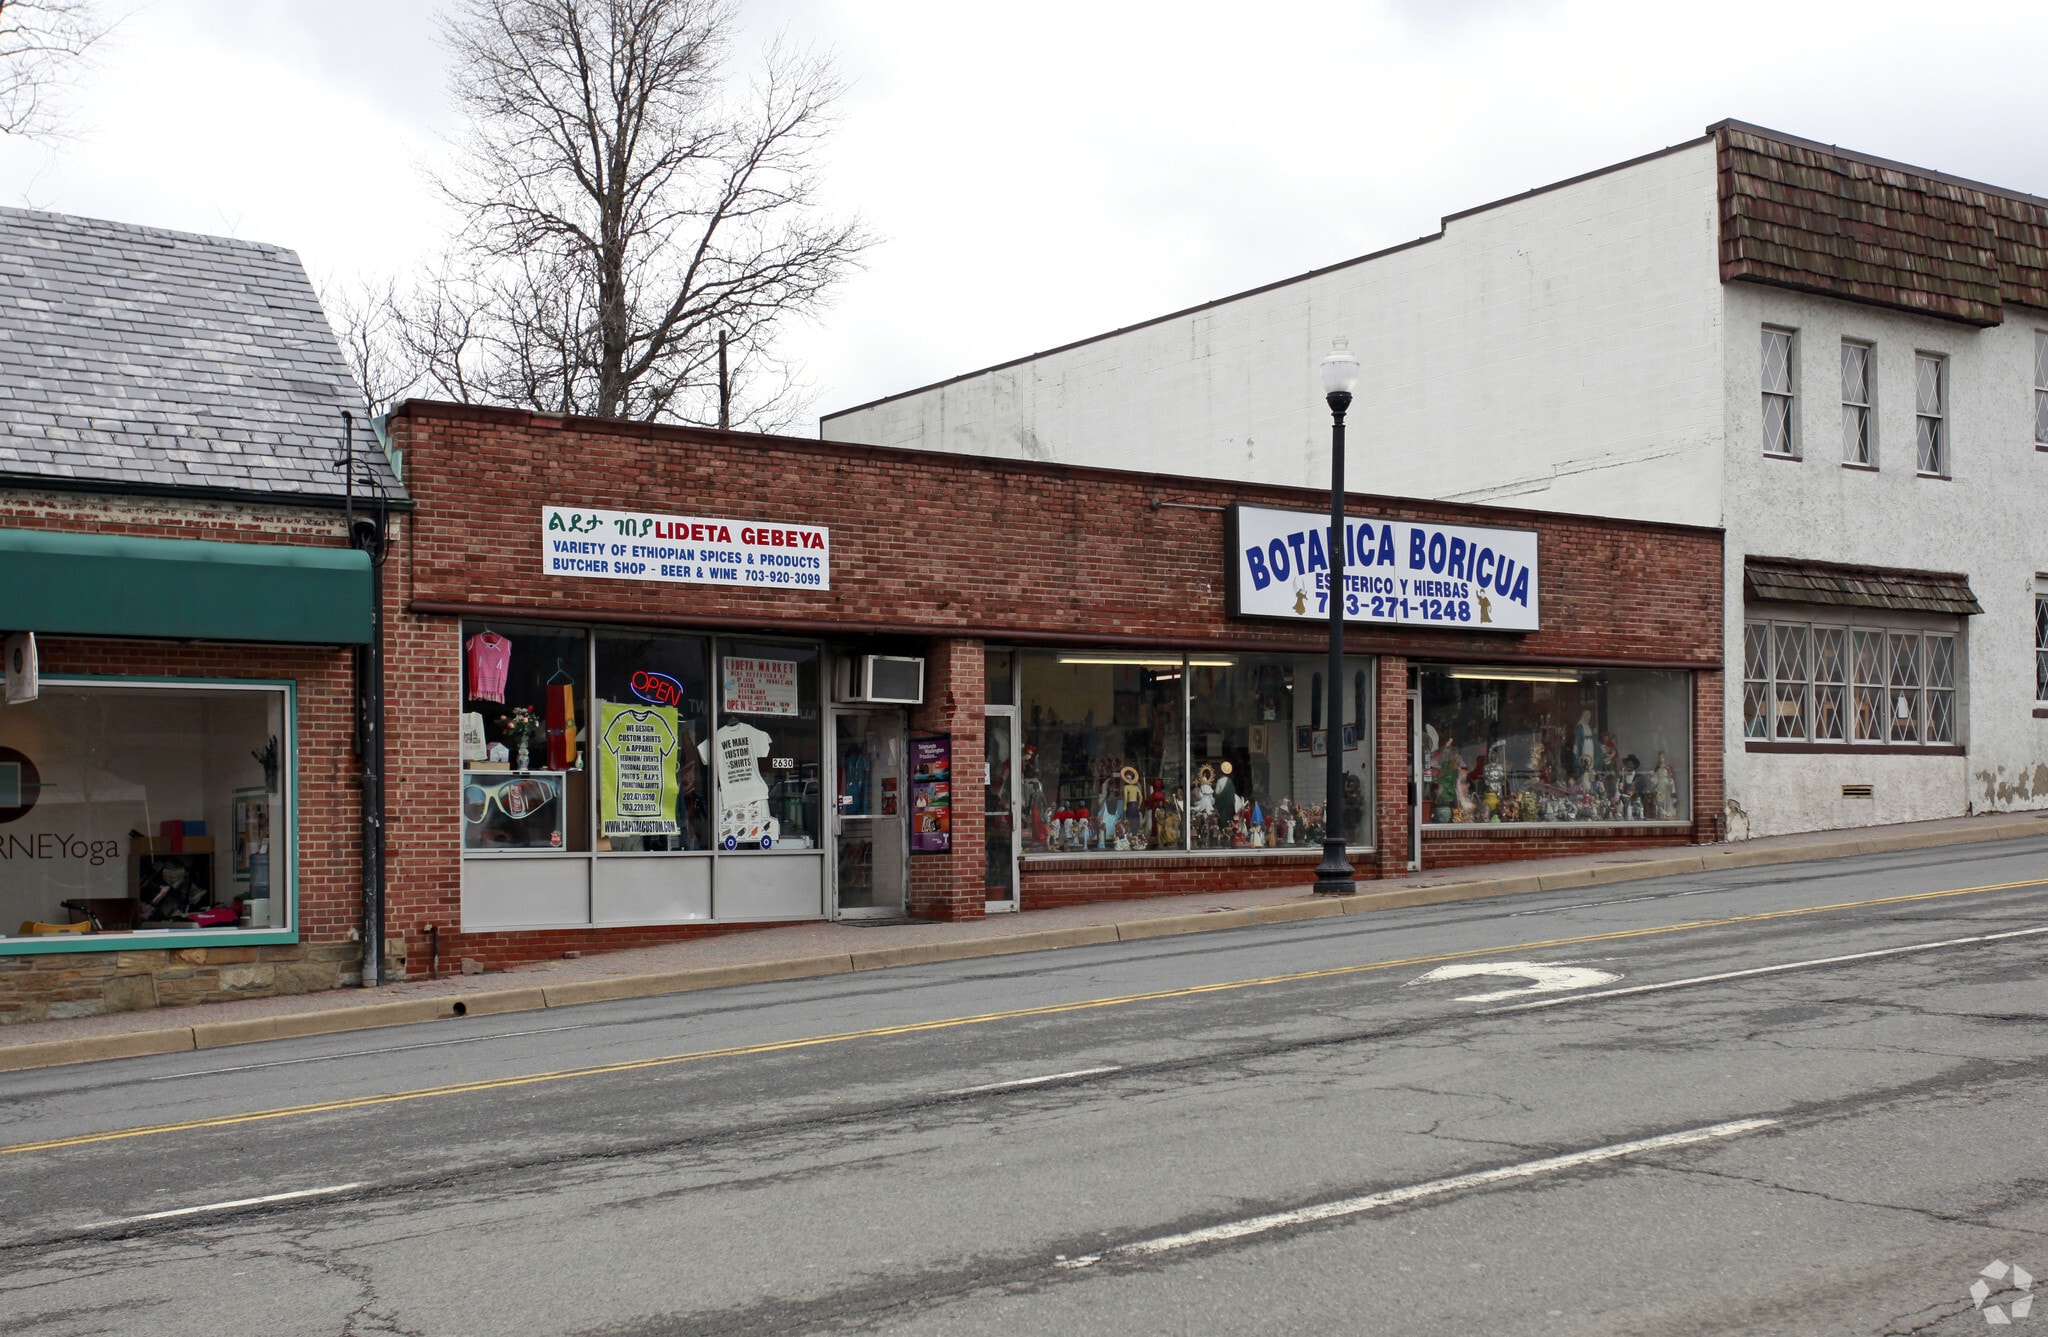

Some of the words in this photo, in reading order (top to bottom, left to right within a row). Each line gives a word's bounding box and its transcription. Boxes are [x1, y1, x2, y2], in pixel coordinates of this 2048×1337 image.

[549, 511, 603, 534] ልደታ
[655, 521, 732, 543] LIDETA
[741, 527, 825, 549] GEBEYA
[553, 540, 606, 556] VARIETY
[611, 543, 627, 557] OF
[632, 545, 695, 561] ETHIOPIAN
[700, 550, 742, 564] SPICES
[747, 553, 755, 564] &
[760, 554, 820, 569] PRODUCTS
[553, 557, 609, 573] BUTCHER
[614, 561, 646, 575] SHOP
[661, 564, 691, 578] BEER
[696, 566, 704, 578] &
[709, 567, 738, 580] WINE
[745, 570, 821, 585] 703-920-3099
[1410, 528, 1529, 608] BORICUA
[1316, 572, 1394, 595] ESTERICO
[1400, 579, 1409, 595] Y
[1414, 580, 1469, 599] HIERBAS
[1316, 592, 1472, 622] 73-271-1248
[726, 659, 754, 671] LIDETA
[759, 661, 794, 674] MARKET
[631, 670, 682, 707] OPEN
[727, 700, 746, 710] OPEN
[618, 734, 641, 742] CUSTOM
[642, 735, 661, 743] SHIRTS
[626, 724, 635, 732] WE
[635, 725, 654, 733] DESIGN
[721, 740, 732, 750] WE
[732, 737, 749, 747] MAKE
[773, 759, 793, 768] 2630
